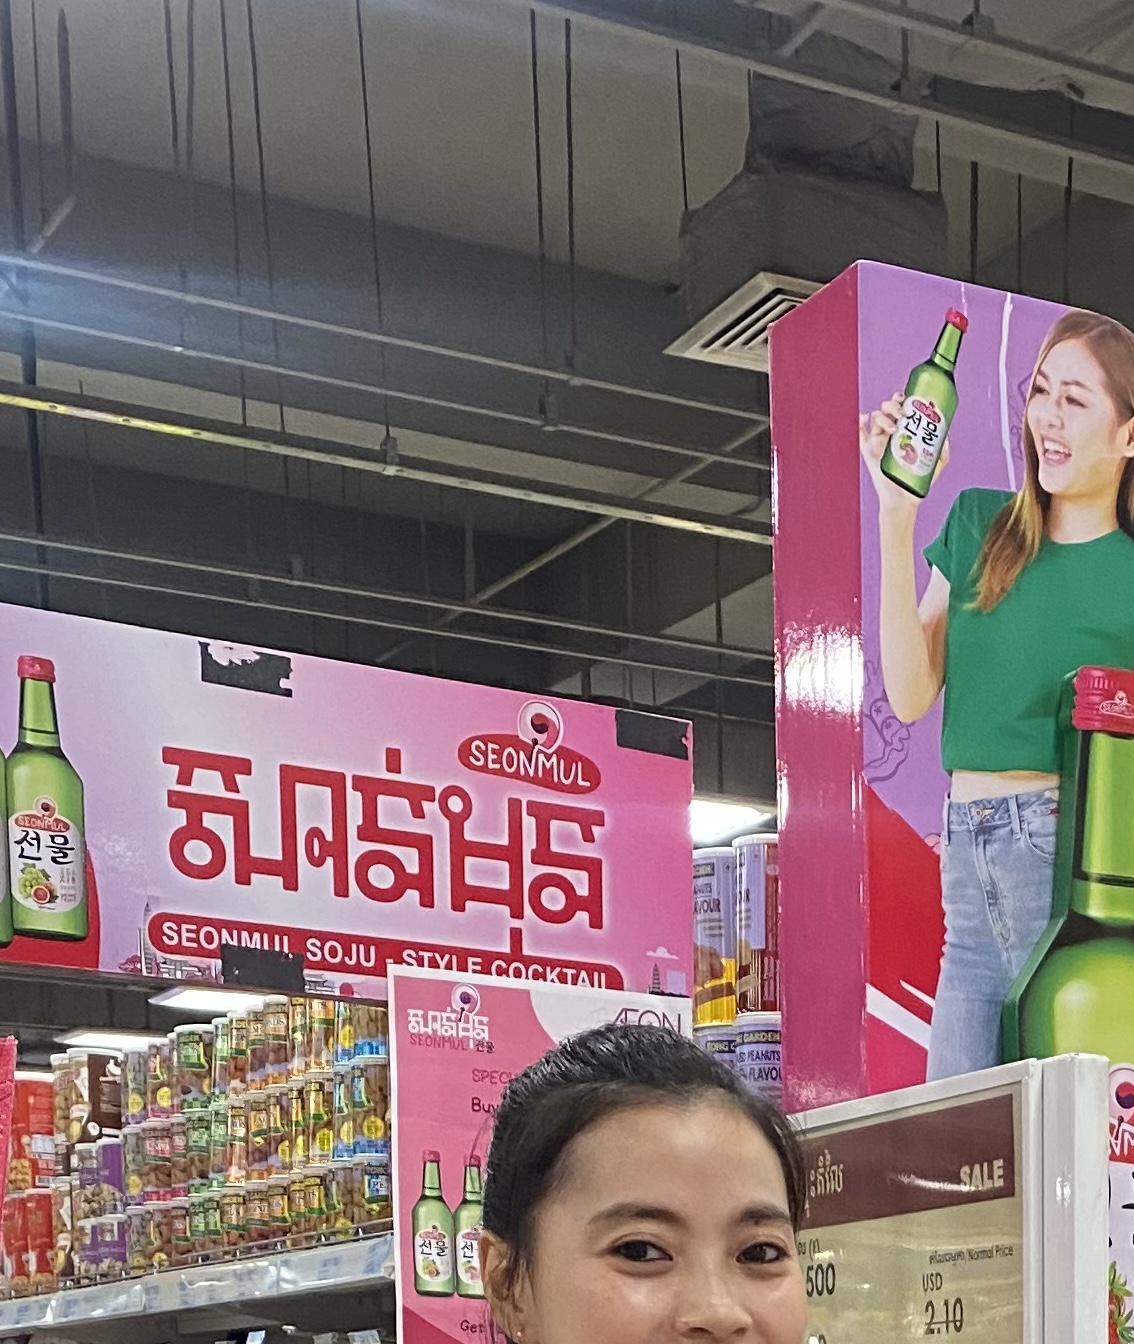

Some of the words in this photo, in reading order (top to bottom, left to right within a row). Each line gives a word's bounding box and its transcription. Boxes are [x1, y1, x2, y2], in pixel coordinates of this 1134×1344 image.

[468, 739, 592, 789] SEONMUL
[305, 938, 377, 967] SOJU
[959, 1158, 1005, 1193] SALE
[922, 1272, 943, 1293] USD
[924, 1296, 964, 1335] 2.10
